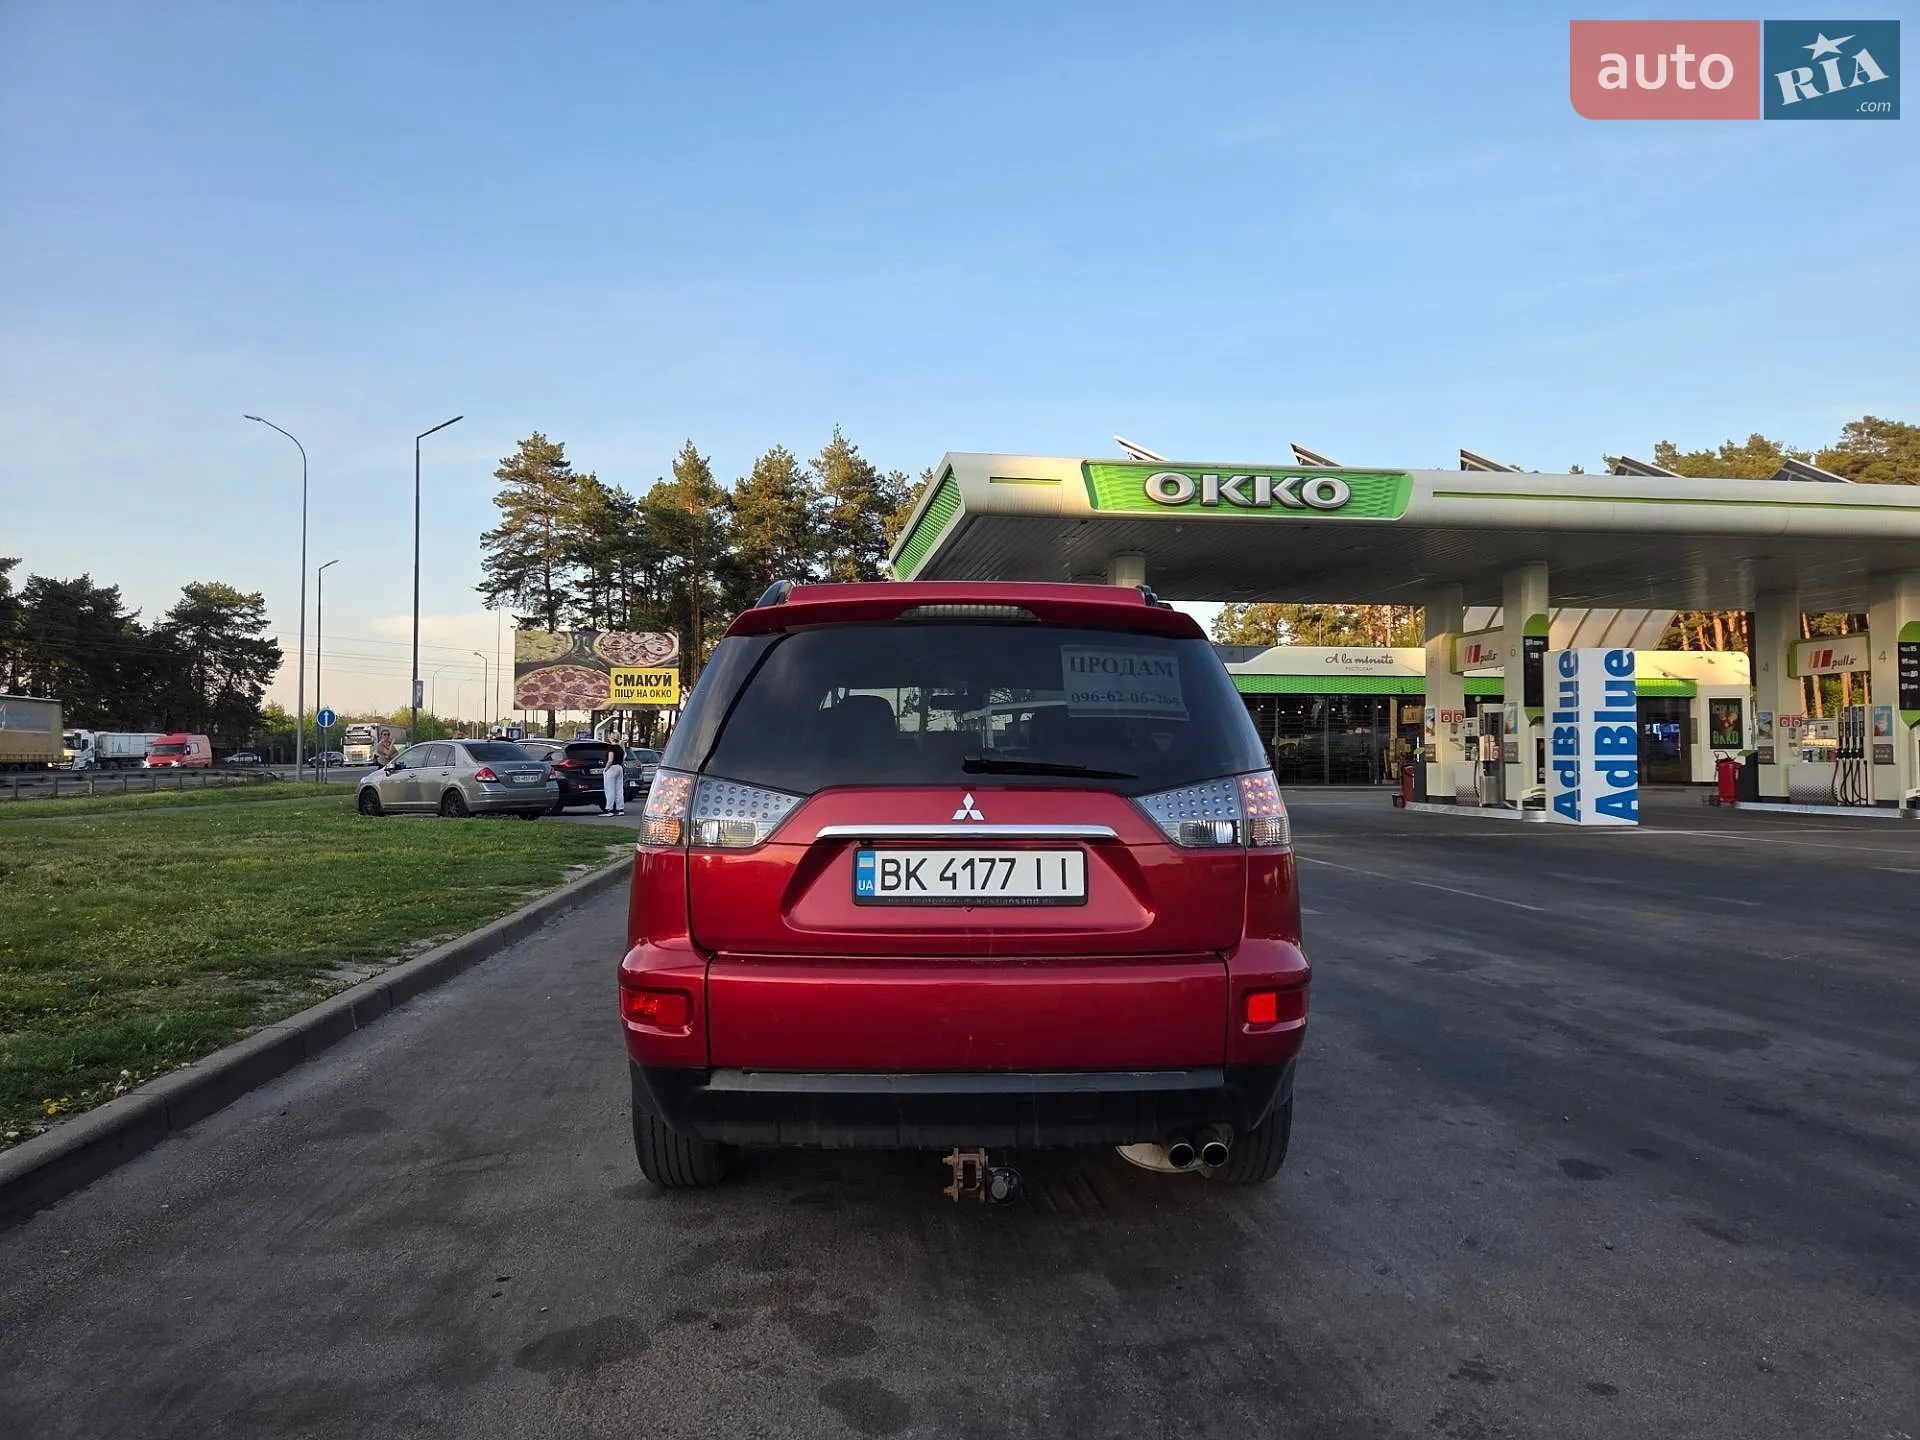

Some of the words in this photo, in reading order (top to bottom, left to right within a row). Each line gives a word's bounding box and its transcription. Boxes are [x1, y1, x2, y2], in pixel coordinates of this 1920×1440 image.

[1143, 470, 1352, 510] OKKO
[1341, 653, 1353, 664] la
[1831, 654, 1857, 669] pulls
[1879, 649, 1887, 662] 4
[1069, 656, 1175, 678] ПРОДАМ
[614, 672, 672, 687] СМАКУЙ
[614, 688, 635, 699] ПІЦУ
[637, 688, 648, 698] НА
[649, 688, 672, 698] ОККО
[1552, 650, 1581, 822] AdBlue
[1593, 649, 1639, 822] AdBlue
[880, 858, 928, 890] BK
[939, 857, 1017, 890] 4177
[858, 880, 873, 891] UA
